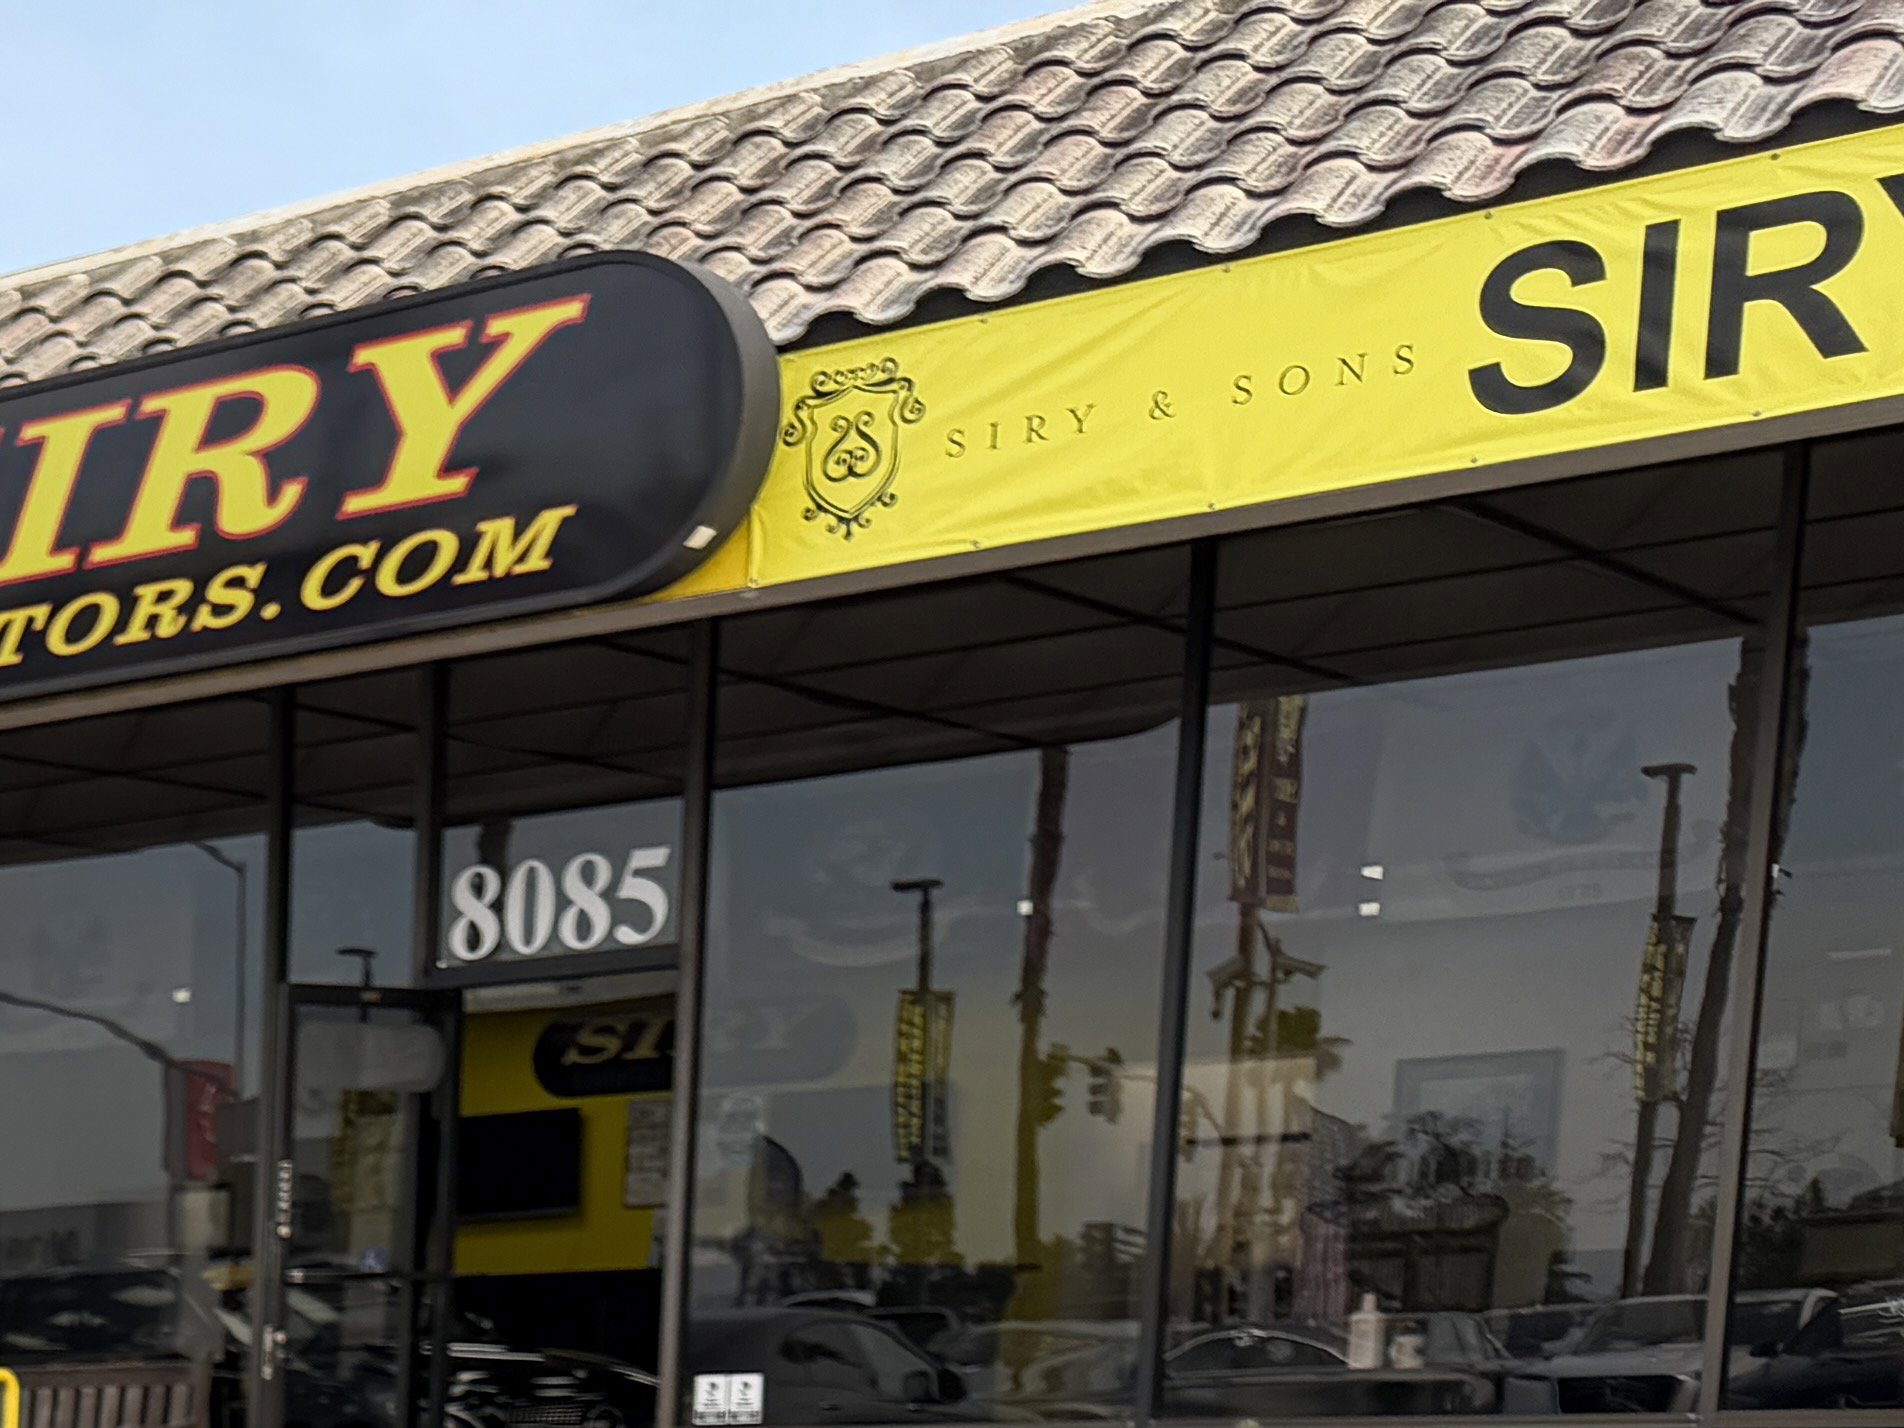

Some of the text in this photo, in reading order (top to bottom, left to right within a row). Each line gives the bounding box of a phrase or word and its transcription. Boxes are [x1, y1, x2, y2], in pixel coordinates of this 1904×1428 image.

[1467, 172, 1904, 415] SIR
[945, 343, 1420, 459] SIRY & SONS
[448, 845, 672, 962] 8085
